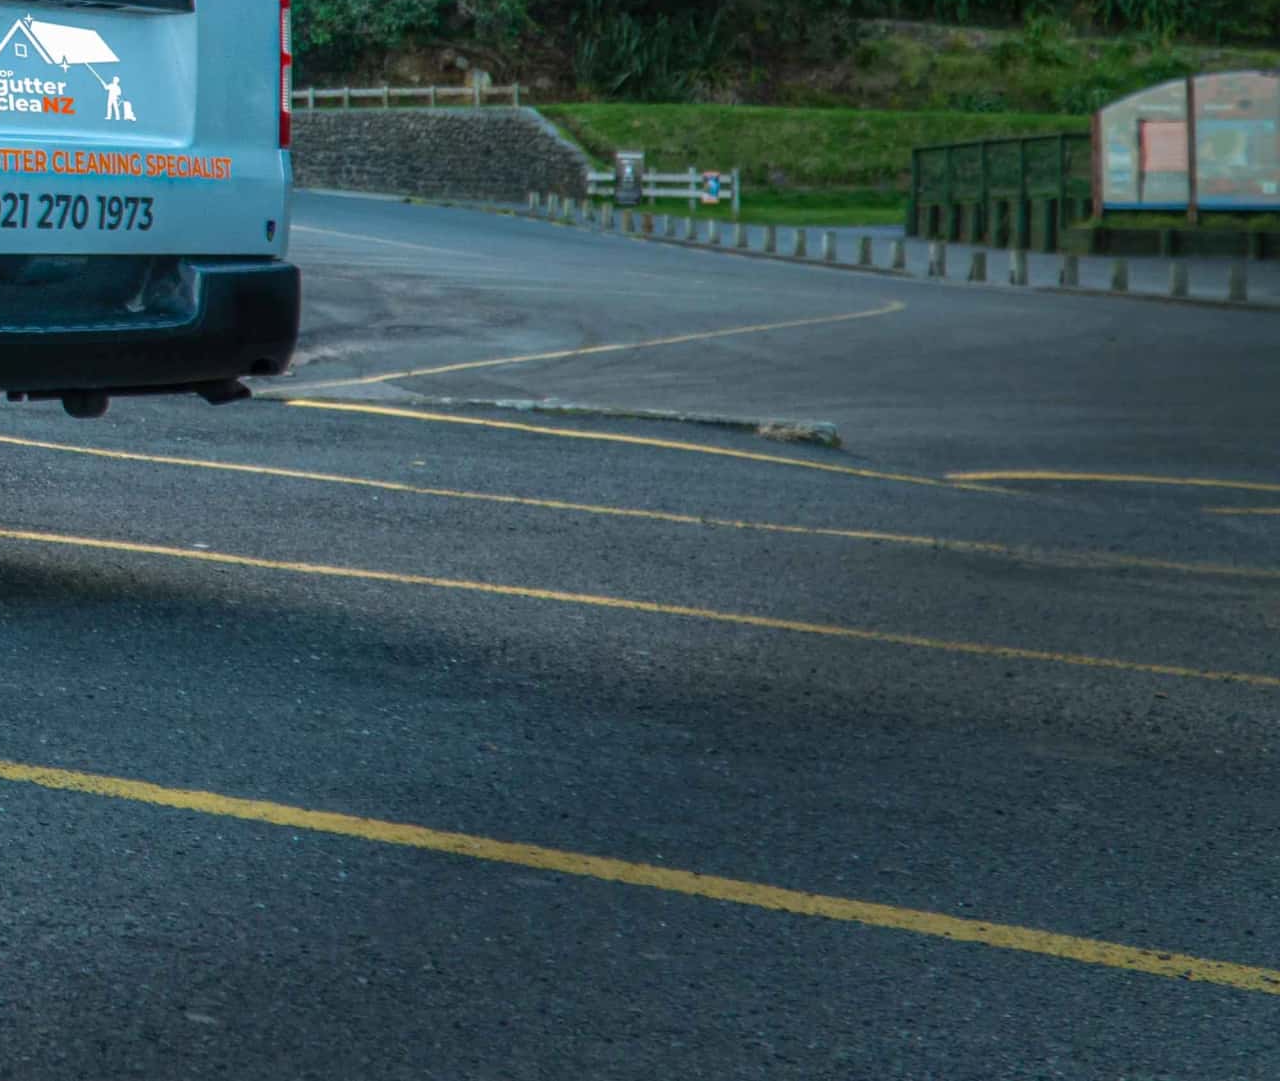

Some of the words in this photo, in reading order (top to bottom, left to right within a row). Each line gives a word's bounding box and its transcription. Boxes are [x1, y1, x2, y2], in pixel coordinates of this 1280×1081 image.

[53, 150, 141, 176] CLEANING
[145, 154, 232, 179] SPECIALIST
[39, 194, 89, 230] 270
[97, 195, 154, 231] 1973
